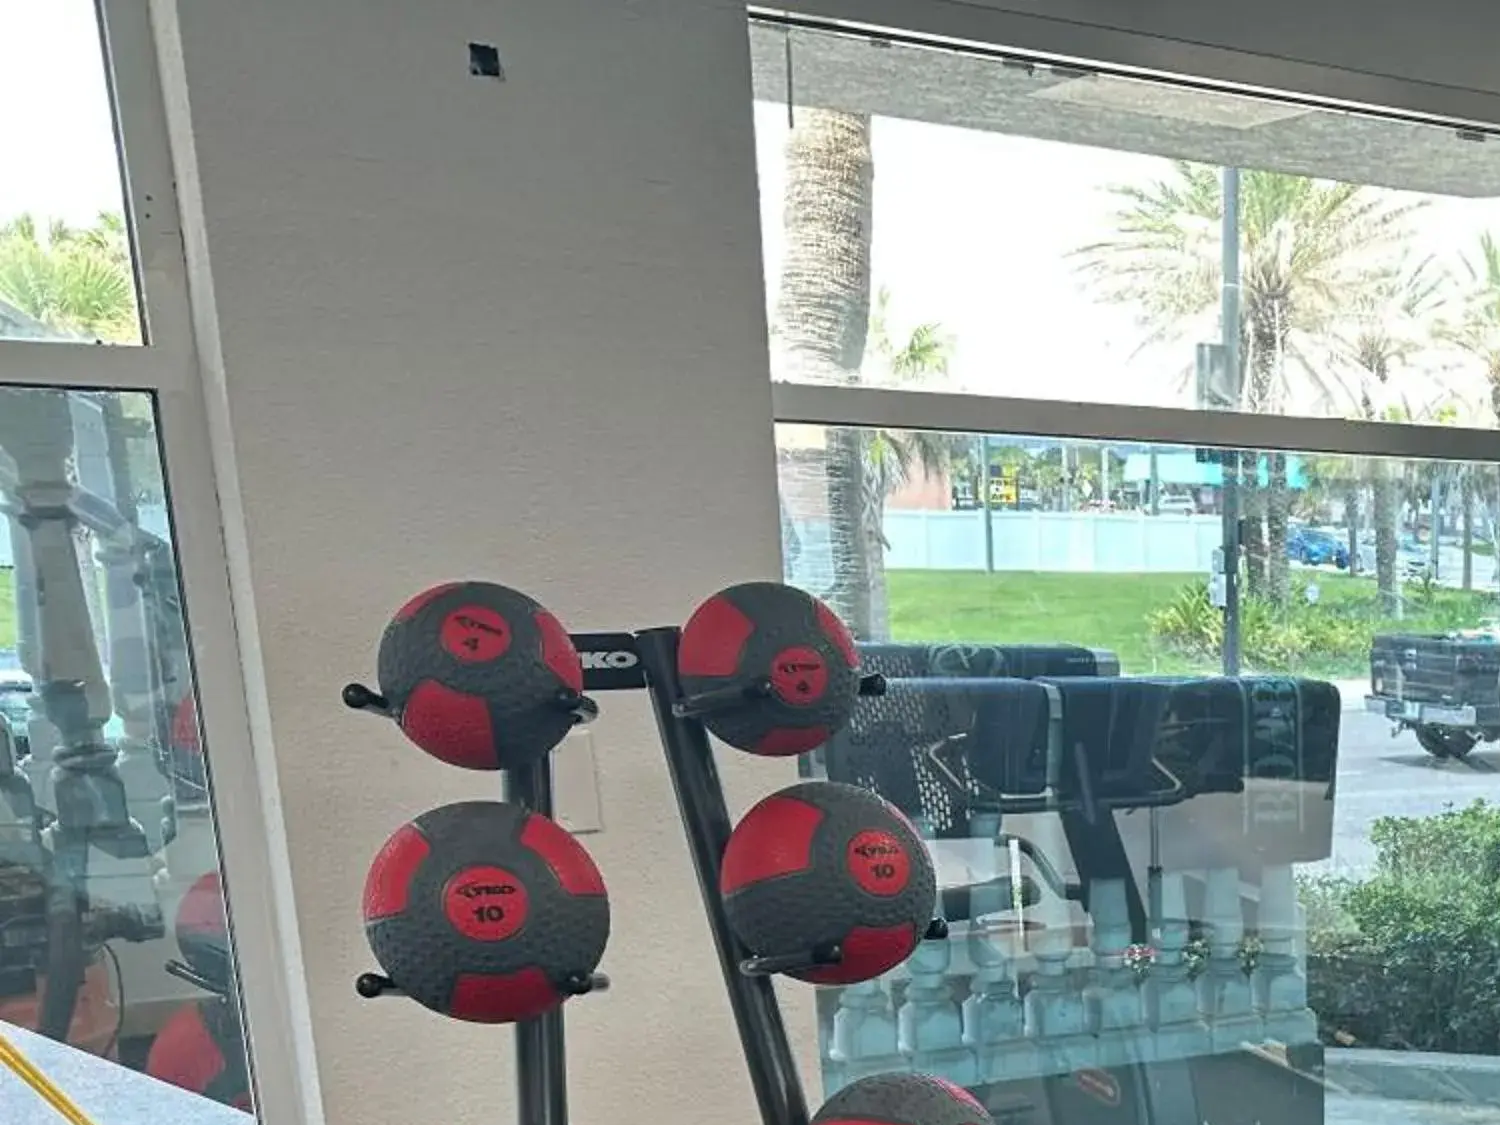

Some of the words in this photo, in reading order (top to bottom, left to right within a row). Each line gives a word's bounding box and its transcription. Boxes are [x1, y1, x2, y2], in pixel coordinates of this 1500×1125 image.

[579, 651, 640, 669] KO
[870, 864, 896, 879] 10
[473, 906, 504, 923] 10
